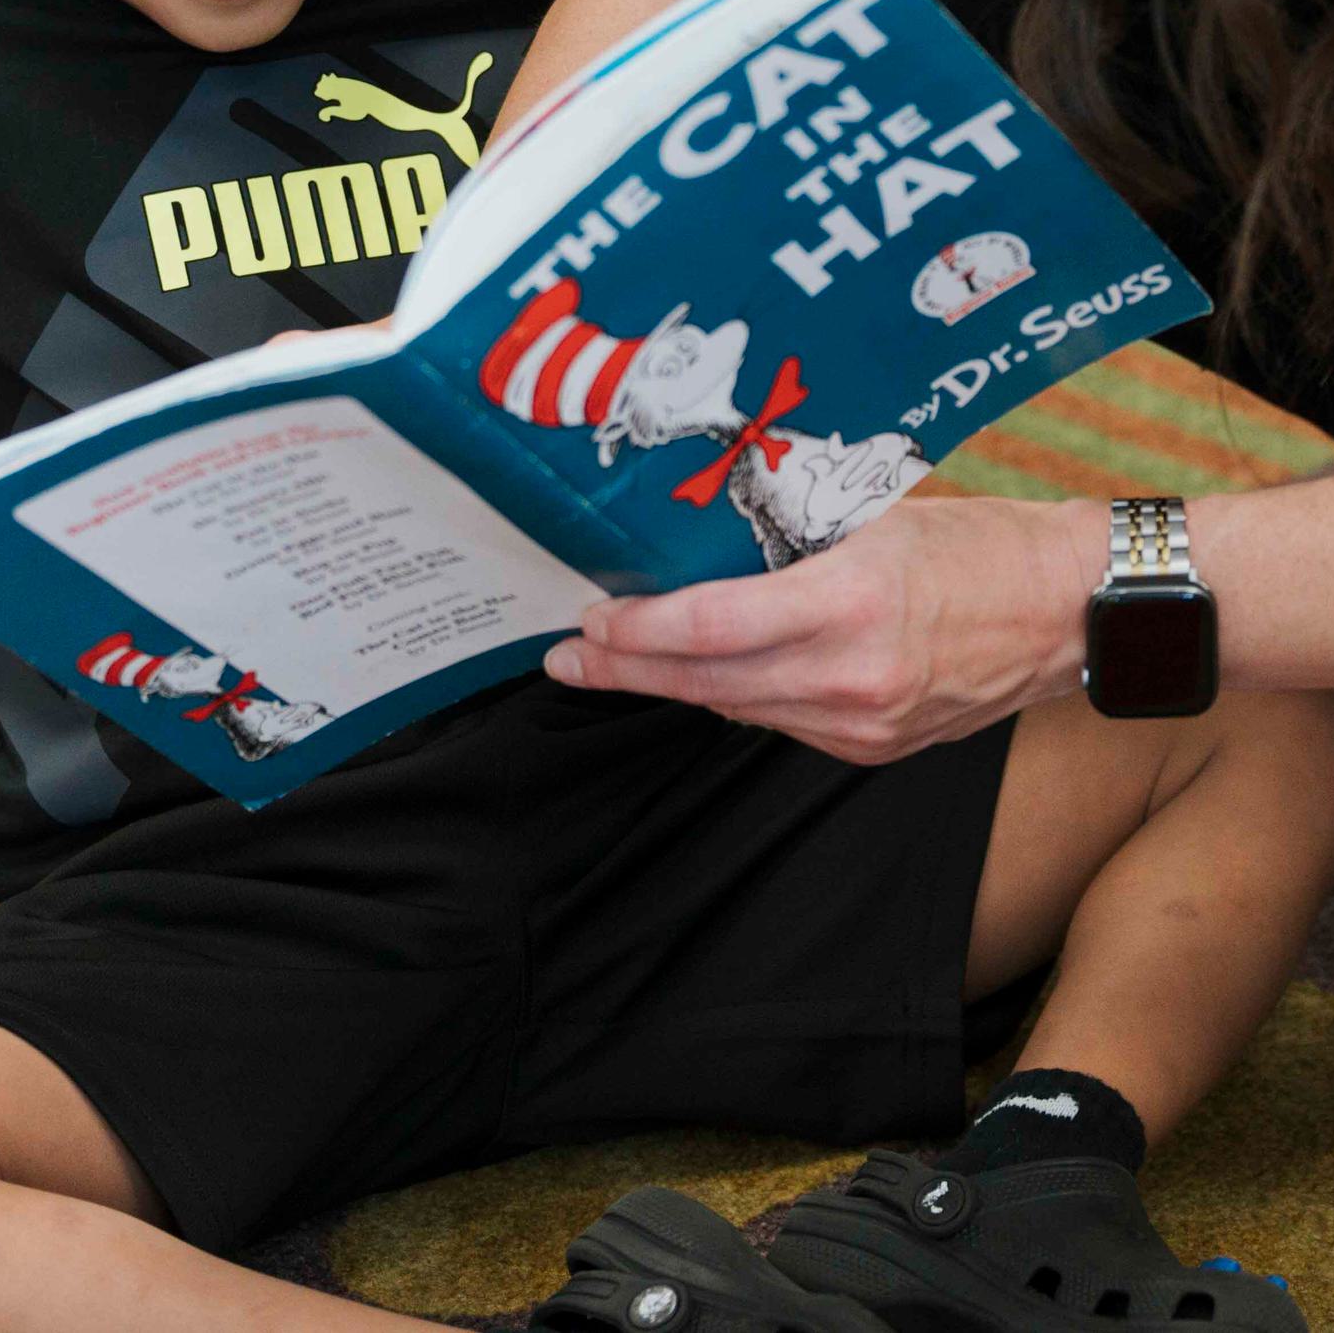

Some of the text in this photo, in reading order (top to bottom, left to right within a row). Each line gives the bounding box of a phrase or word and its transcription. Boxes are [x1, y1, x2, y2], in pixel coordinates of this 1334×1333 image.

[784, 87, 873, 161] IN
[785, 104, 932, 205] THE
[141, 153, 449, 293] PUMA
[509, 176, 663, 300] THE
[772, 100, 1022, 297] HAT
[930, 343, 1029, 409] Dr.
[1019, 263, 1172, 351] Seuss
